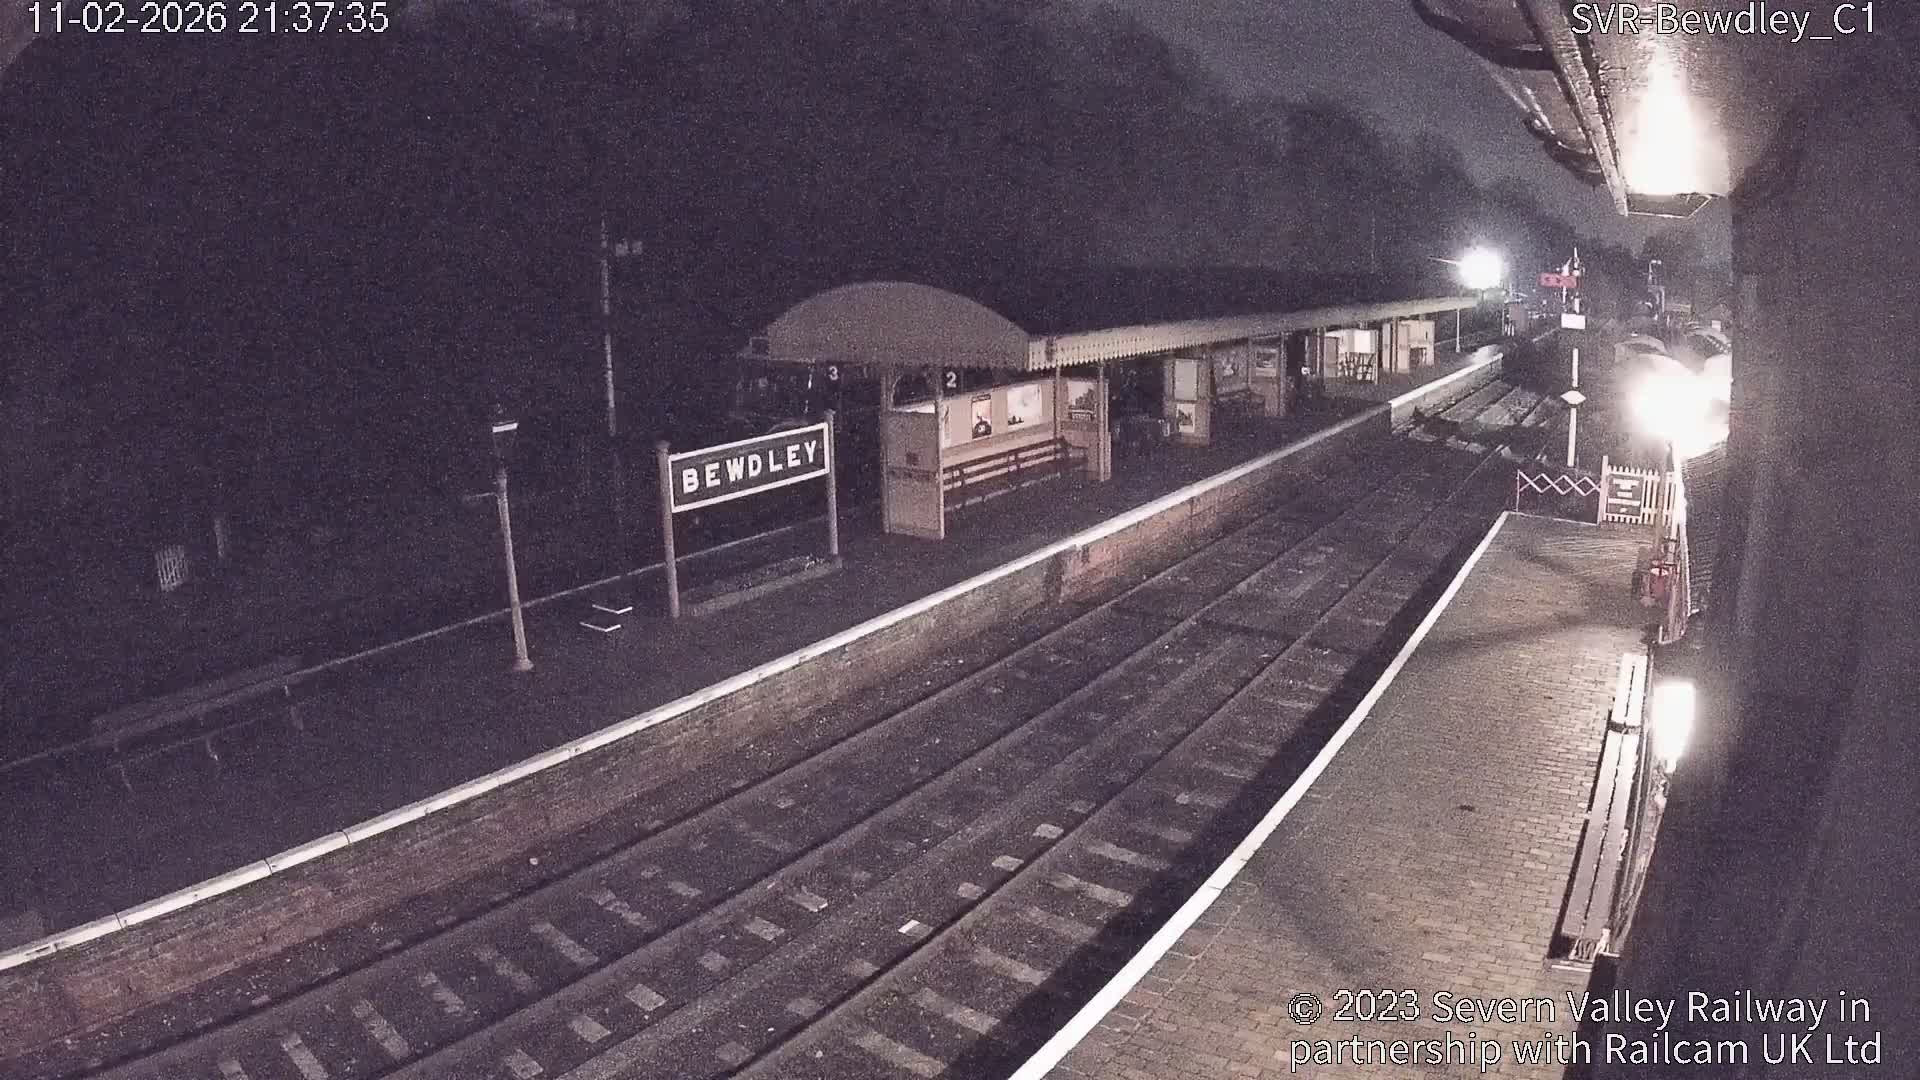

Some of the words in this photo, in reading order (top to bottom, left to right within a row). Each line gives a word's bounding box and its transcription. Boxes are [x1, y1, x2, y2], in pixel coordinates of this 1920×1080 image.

[828, 365, 840, 381] 3
[945, 371, 958, 388] 2
[682, 440, 818, 494] BEWDLEY
